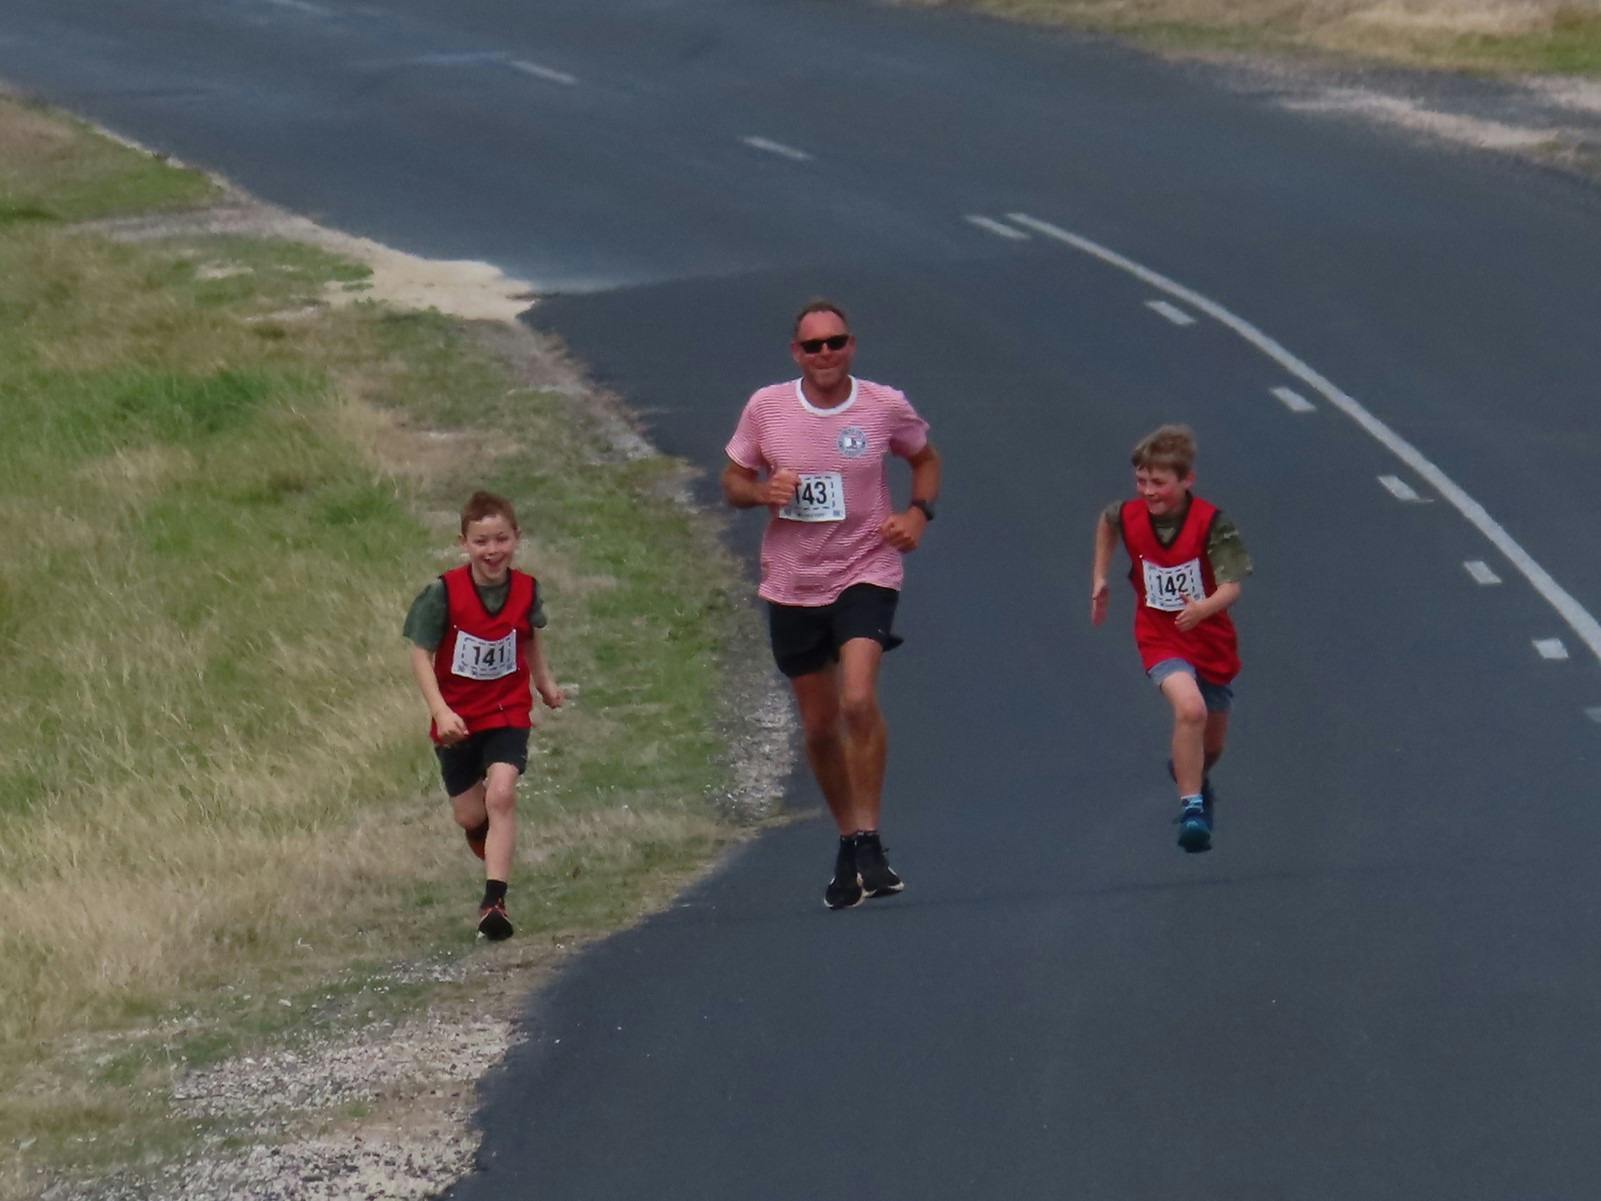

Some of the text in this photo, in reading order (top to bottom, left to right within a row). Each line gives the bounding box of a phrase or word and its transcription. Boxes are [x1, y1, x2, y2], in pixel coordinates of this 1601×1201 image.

[795, 481, 827, 505] 143
[1156, 573, 1189, 596] 142
[473, 645, 505, 667] 141
